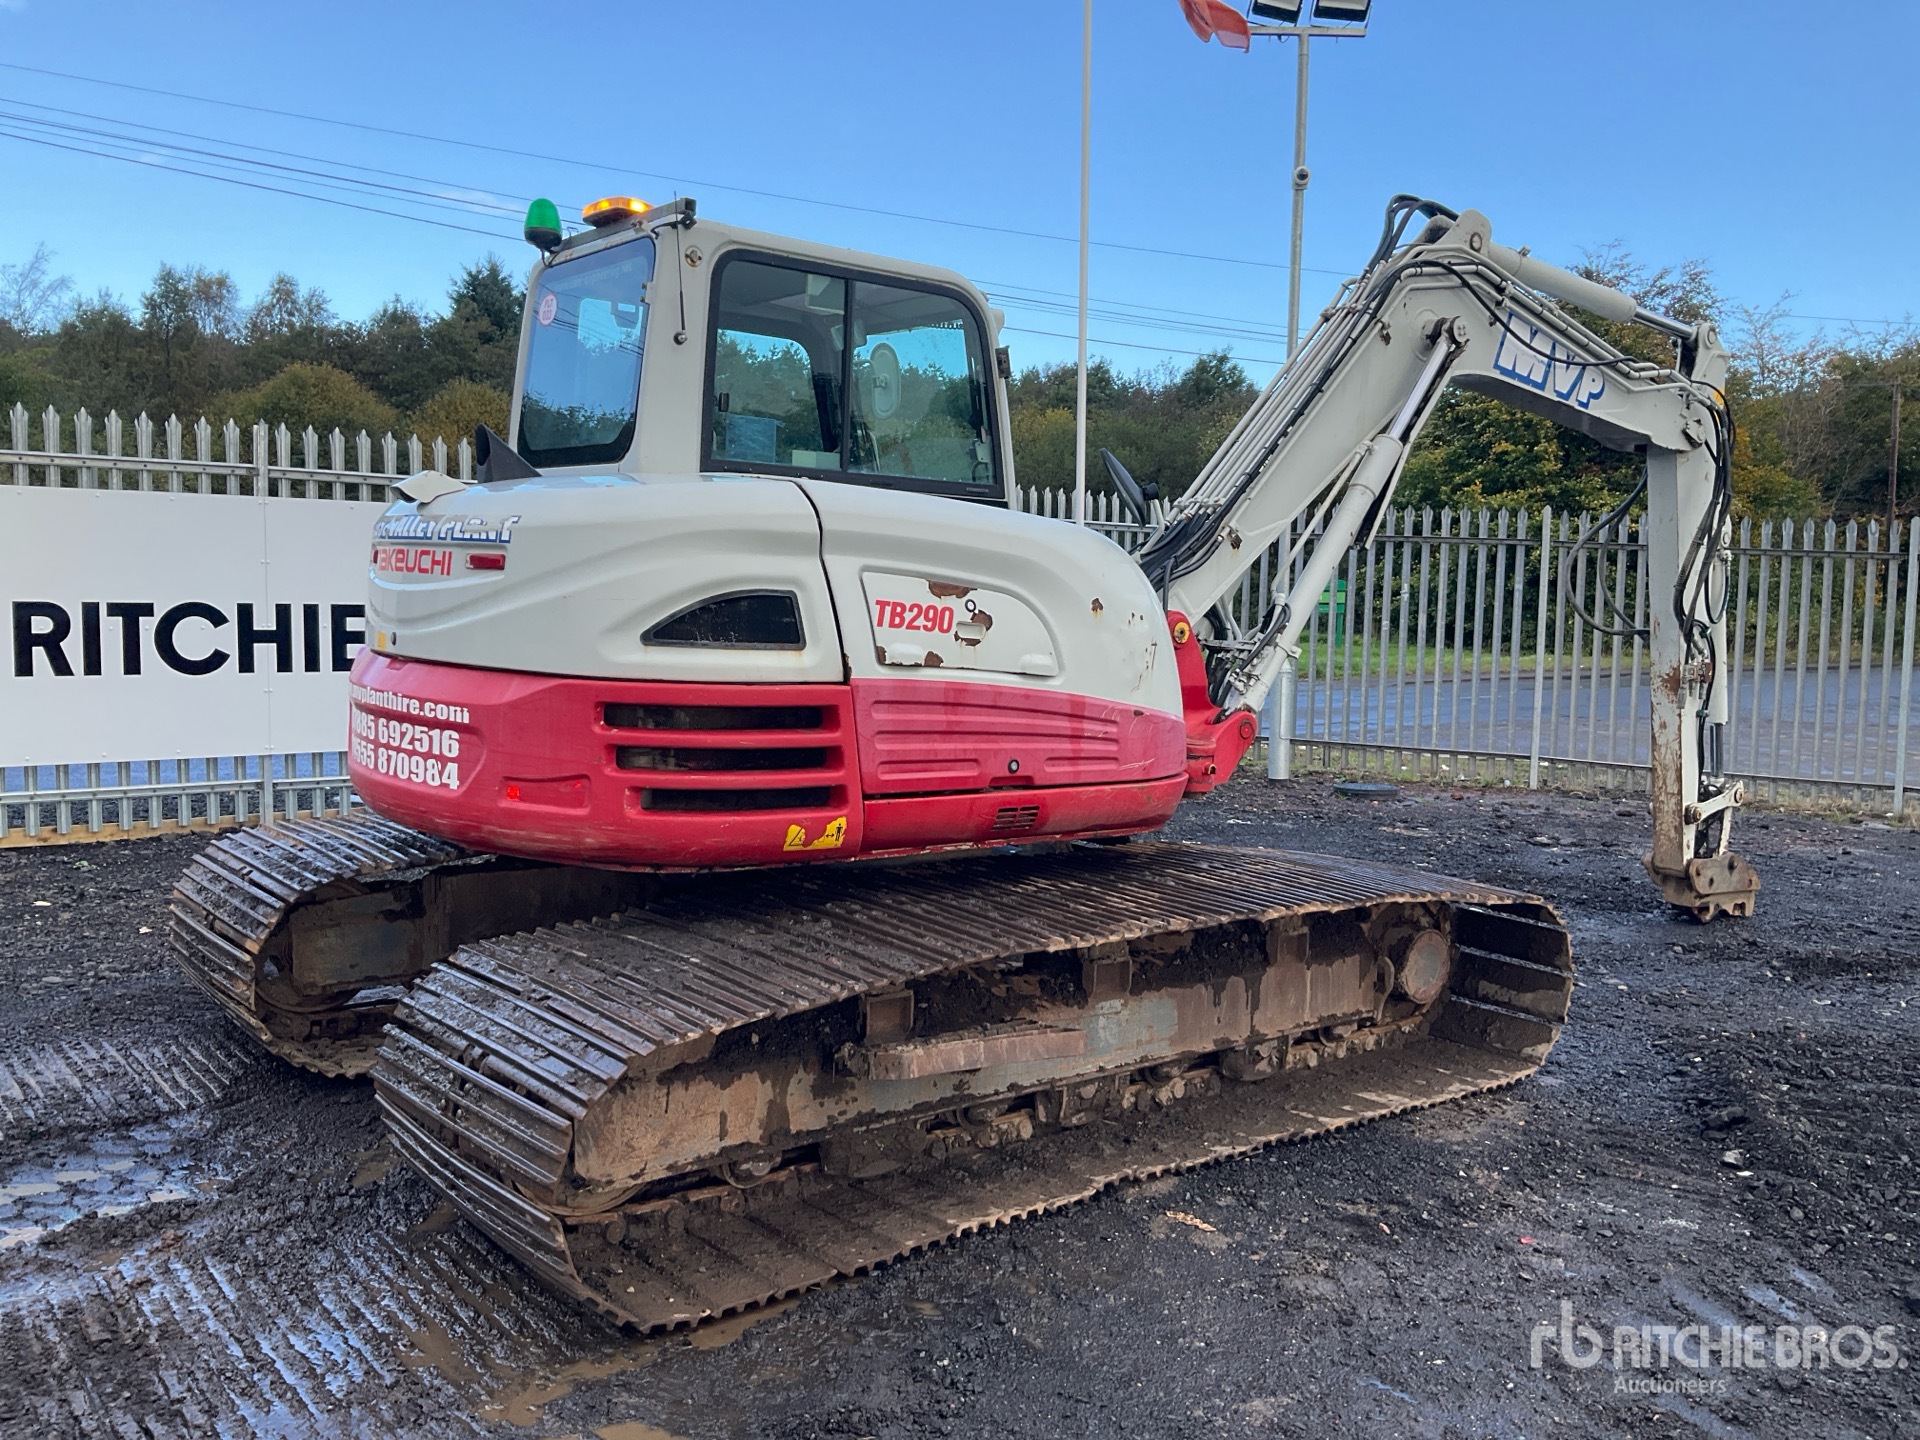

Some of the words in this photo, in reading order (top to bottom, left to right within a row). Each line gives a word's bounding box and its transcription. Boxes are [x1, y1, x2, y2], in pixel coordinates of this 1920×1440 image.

[1492, 311, 1605, 410] MVP
[875, 600, 954, 633] TB290
[12, 600, 366, 677] RITCHIE
[378, 718, 460, 757] 692516
[378, 748, 460, 790] 870984
